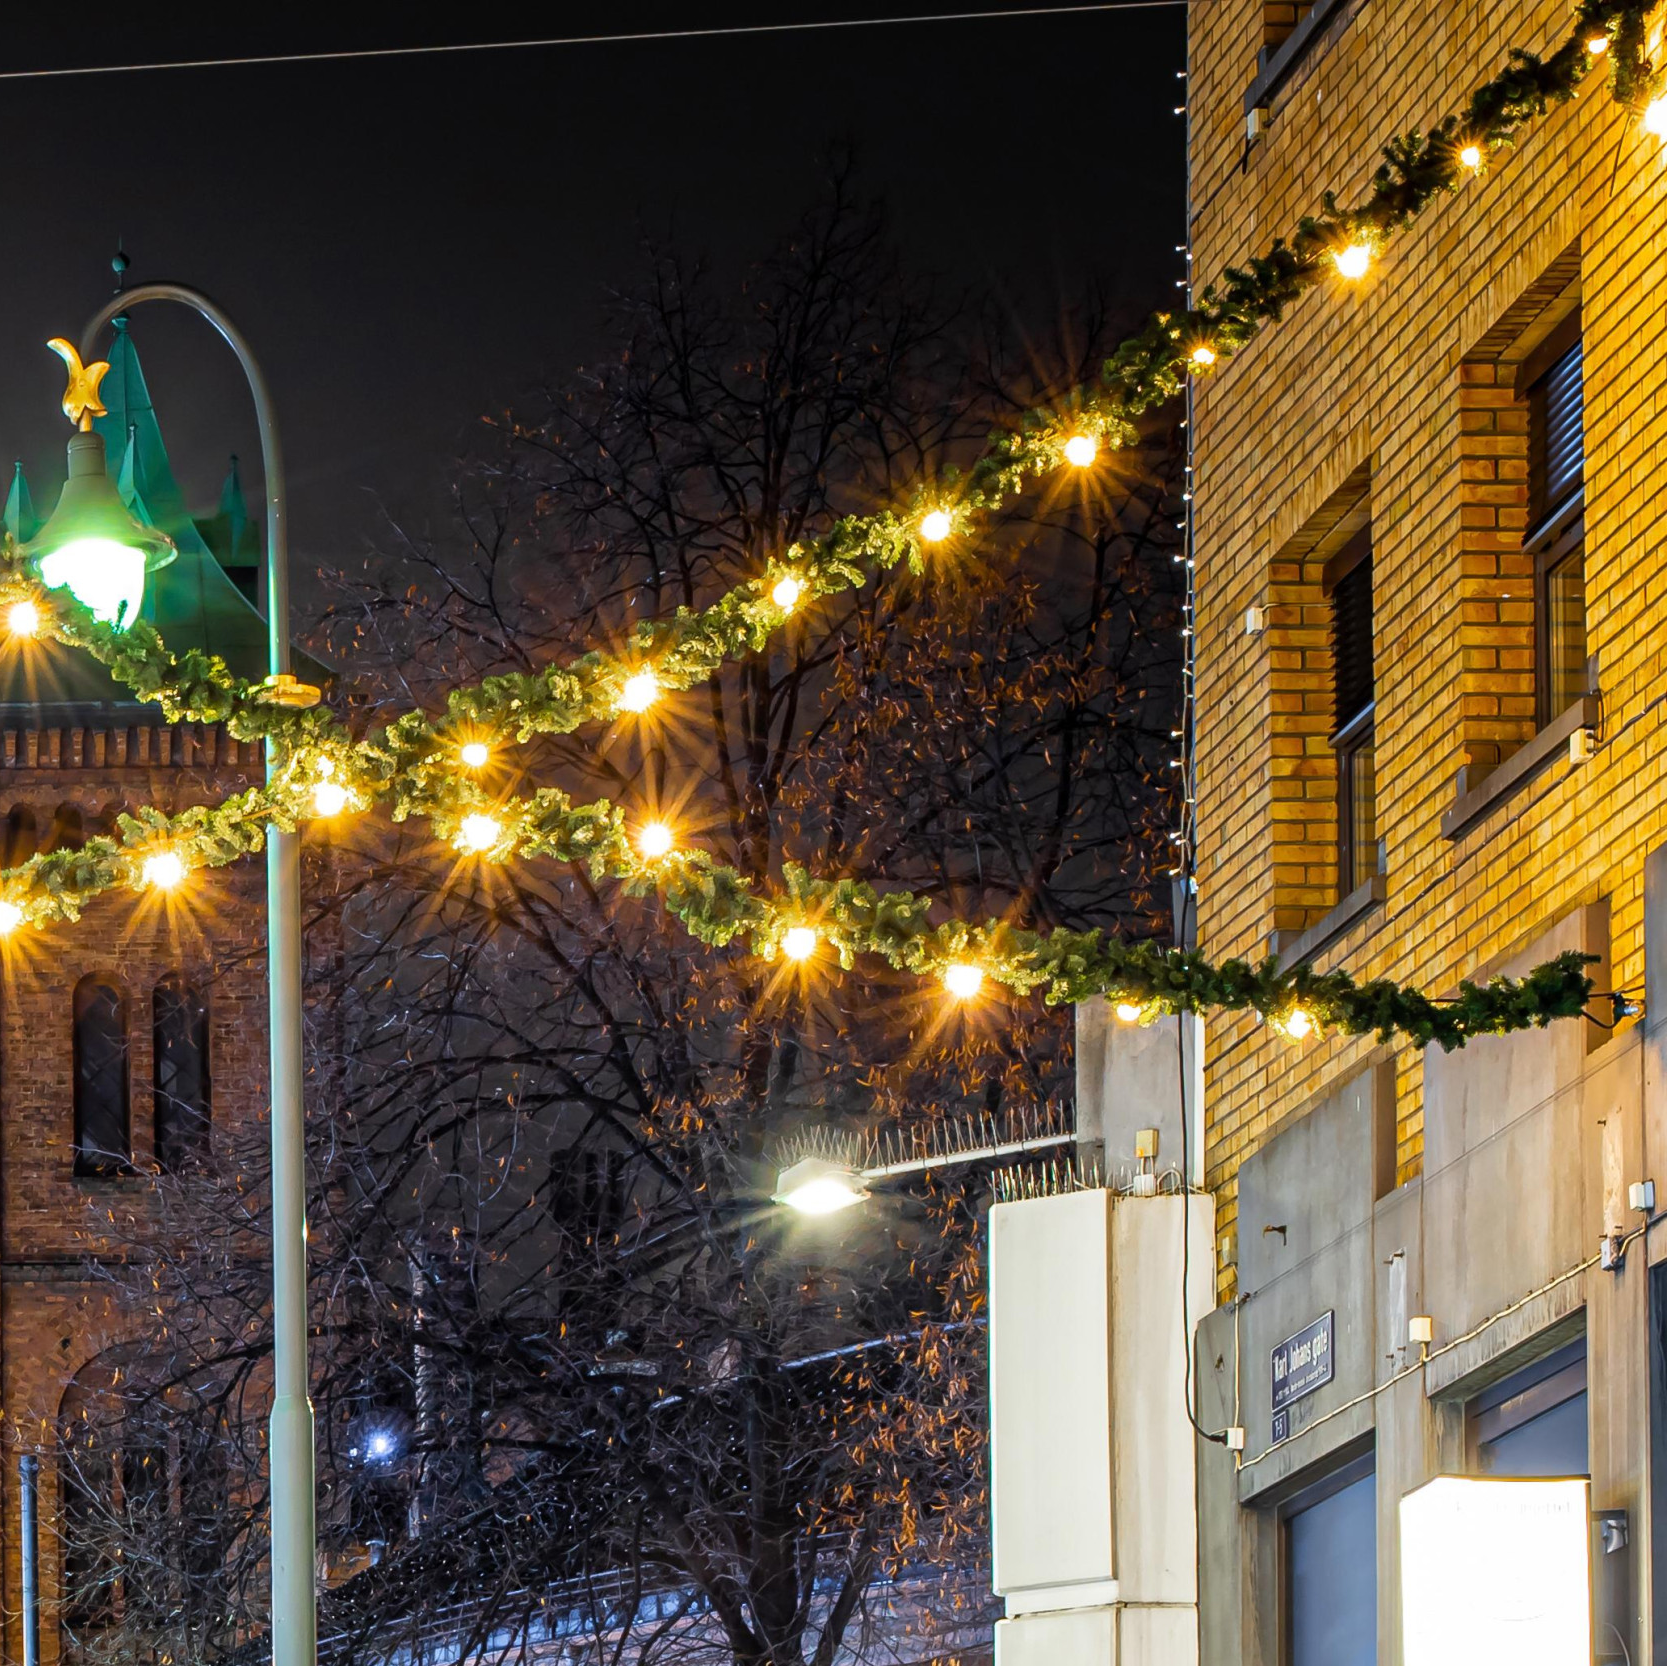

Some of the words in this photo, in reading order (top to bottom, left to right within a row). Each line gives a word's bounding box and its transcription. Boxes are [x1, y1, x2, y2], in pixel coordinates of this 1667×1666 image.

[1273, 1350, 1288, 1383] Karl
[1289, 1340, 1312, 1374] Johans
[1312, 1327, 1328, 1367] gate
